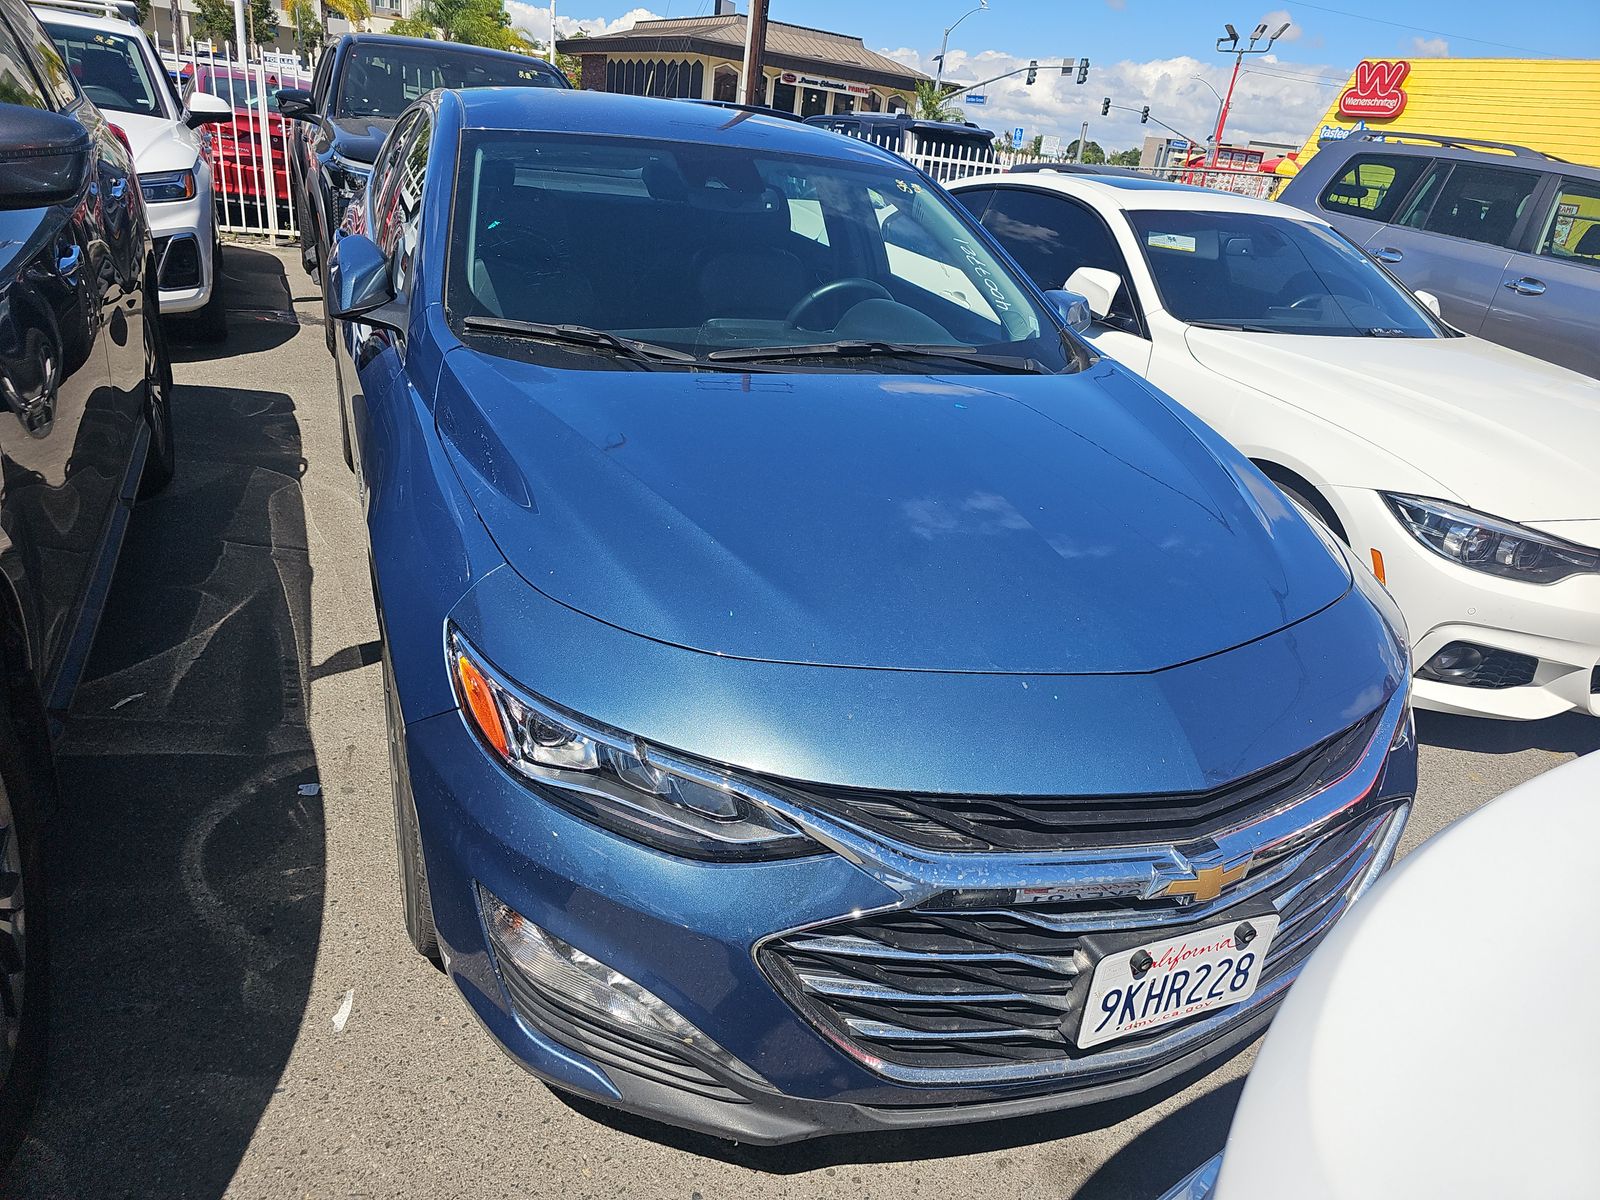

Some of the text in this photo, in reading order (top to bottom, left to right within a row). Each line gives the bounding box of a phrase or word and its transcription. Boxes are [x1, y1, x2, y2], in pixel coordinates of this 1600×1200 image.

[1345, 96, 1398, 108] Wienerschnitzel
[1142, 934, 1238, 973] alifornia
[1094, 952, 1256, 1034] 9KHR228
[1123, 1000, 1214, 1032] dmv.ca.gov
